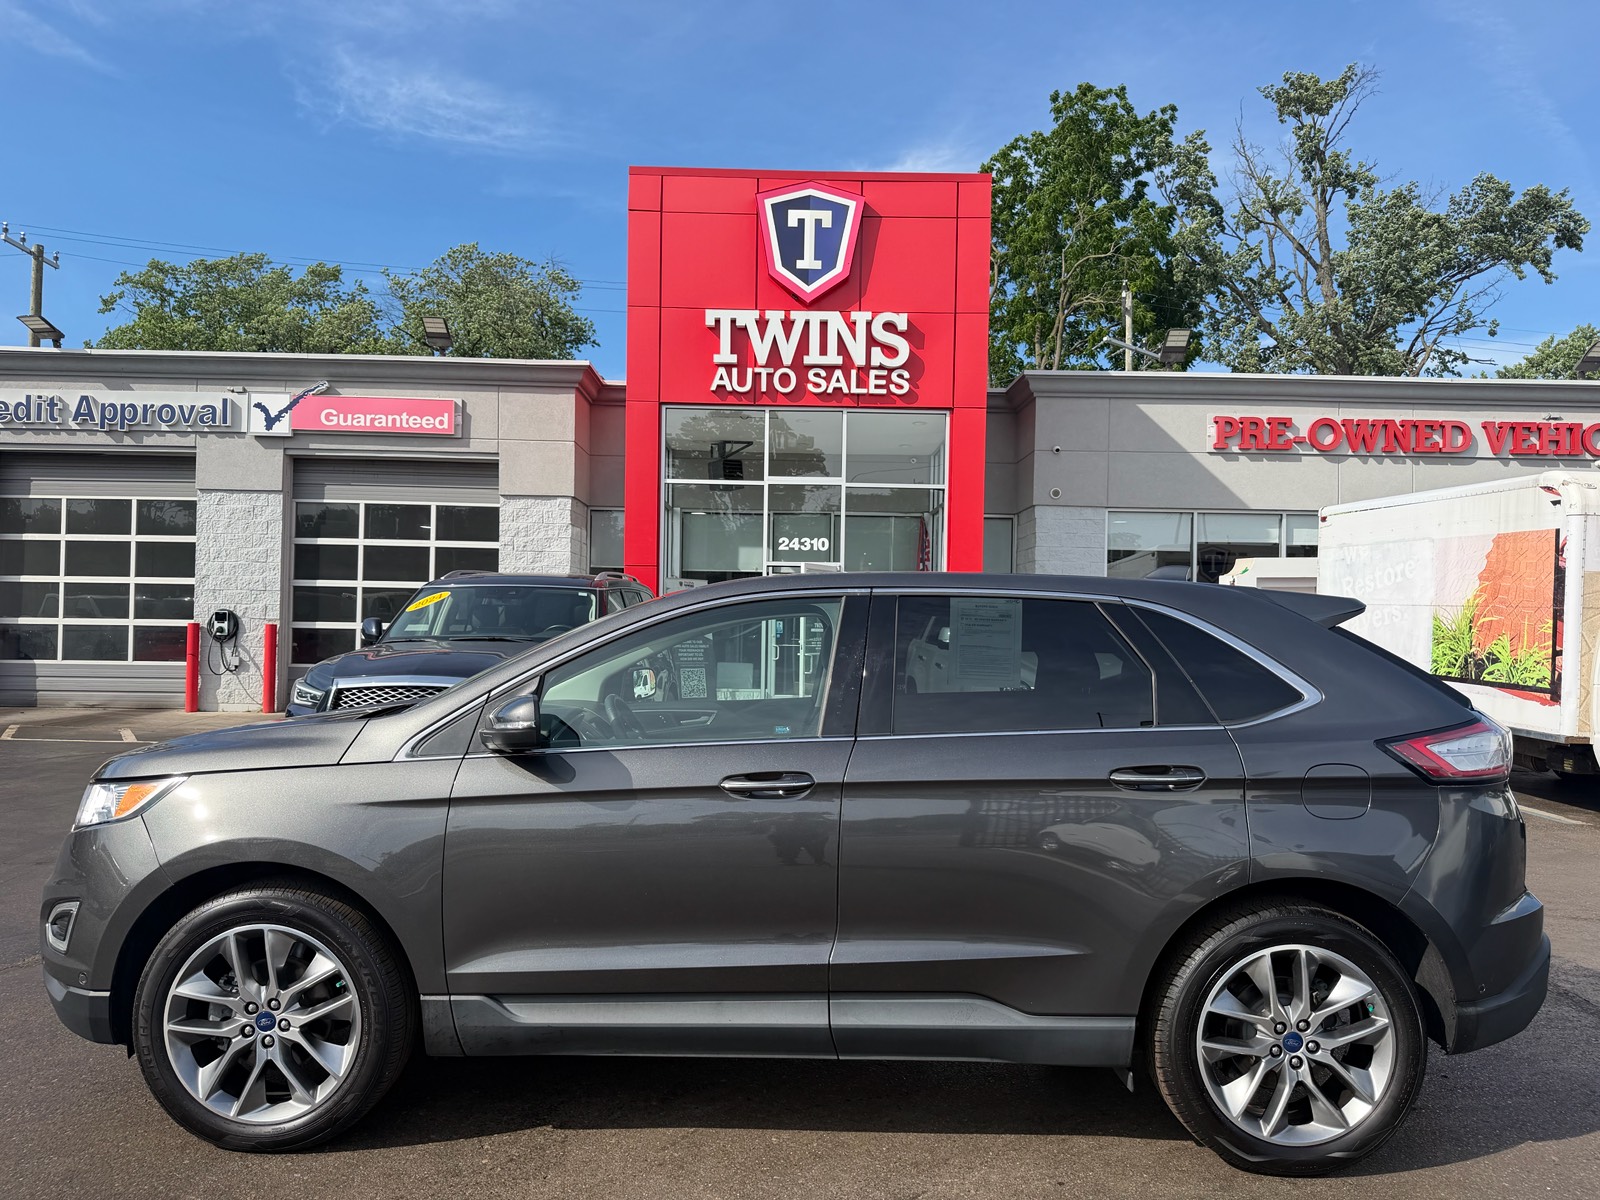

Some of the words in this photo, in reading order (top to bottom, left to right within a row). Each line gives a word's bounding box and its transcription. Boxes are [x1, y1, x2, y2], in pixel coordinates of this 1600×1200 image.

[787, 209, 833, 270] T
[705, 309, 910, 369] TWINS
[709, 366, 797, 394] AUTO
[807, 368, 910, 395] SALES
[72, 395, 229, 431] Approval
[320, 408, 449, 429] Guaranteed
[1213, 415, 1473, 453] PRE-OWNED
[778, 536, 830, 551] 24310
